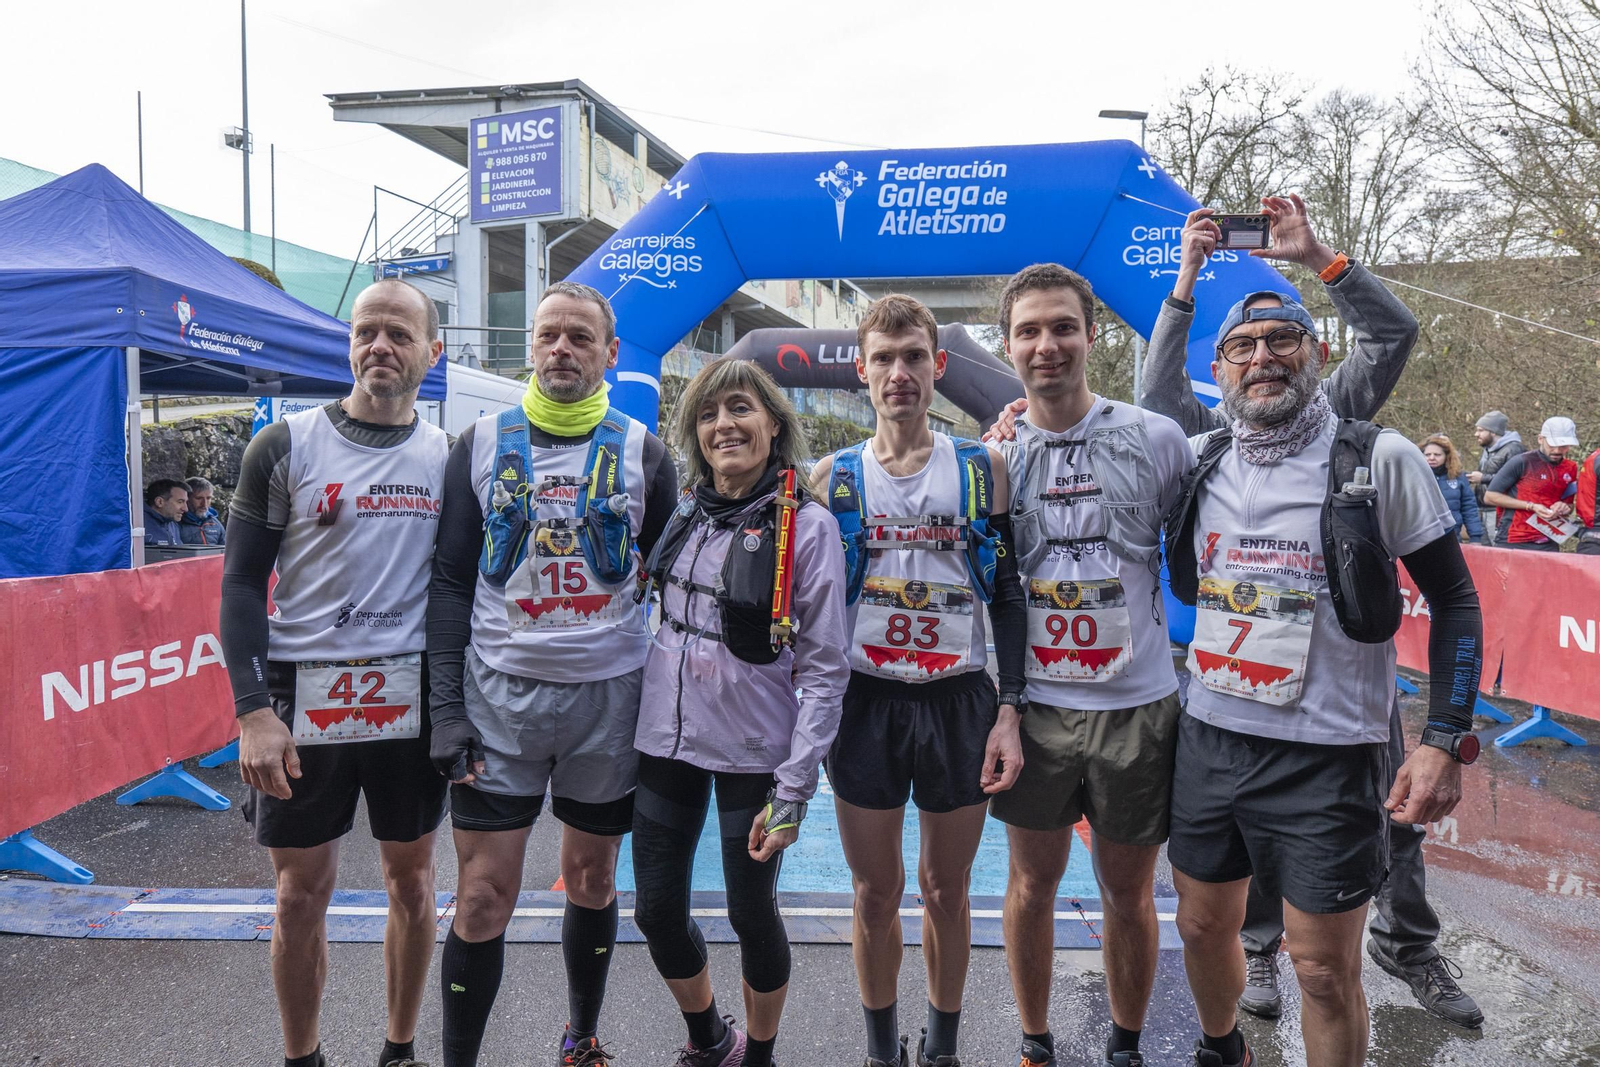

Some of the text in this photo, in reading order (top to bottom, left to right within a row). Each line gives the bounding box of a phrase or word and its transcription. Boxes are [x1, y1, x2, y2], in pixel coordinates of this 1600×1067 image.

[502, 117, 554, 145] MSC
[495, 152, 547, 166] 988 095 870
[878, 160, 1007, 181] Federación
[491, 168, 534, 180] ELEVACION
[491, 179, 536, 191] JARDINERIA
[491, 188, 551, 201] CONSTRUCCION
[877, 181, 1007, 213] Galega de
[491, 202, 527, 212] LIMPIEZA
[878, 209, 1006, 236] Atletismo
[600, 250, 702, 278] Galegas
[1122, 242, 1239, 269] Galeas
[189, 322, 264, 351] Federación Galega
[369, 484, 431, 498] ENTRENA
[1055, 473, 1094, 487] ENTREN
[1239, 538, 1310, 553] ENTRENA
[540, 561, 588, 595] 15
[1225, 562, 1327, 581] entrenarunning.com
[353, 617, 403, 627] DA CORUÑA
[356, 610, 402, 620] Deputación
[885, 613, 940, 650] 83
[1045, 614, 1097, 647] 90
[1227, 618, 1253, 655] 7
[41, 633, 227, 721] NISSA
[328, 671, 386, 705] 42
